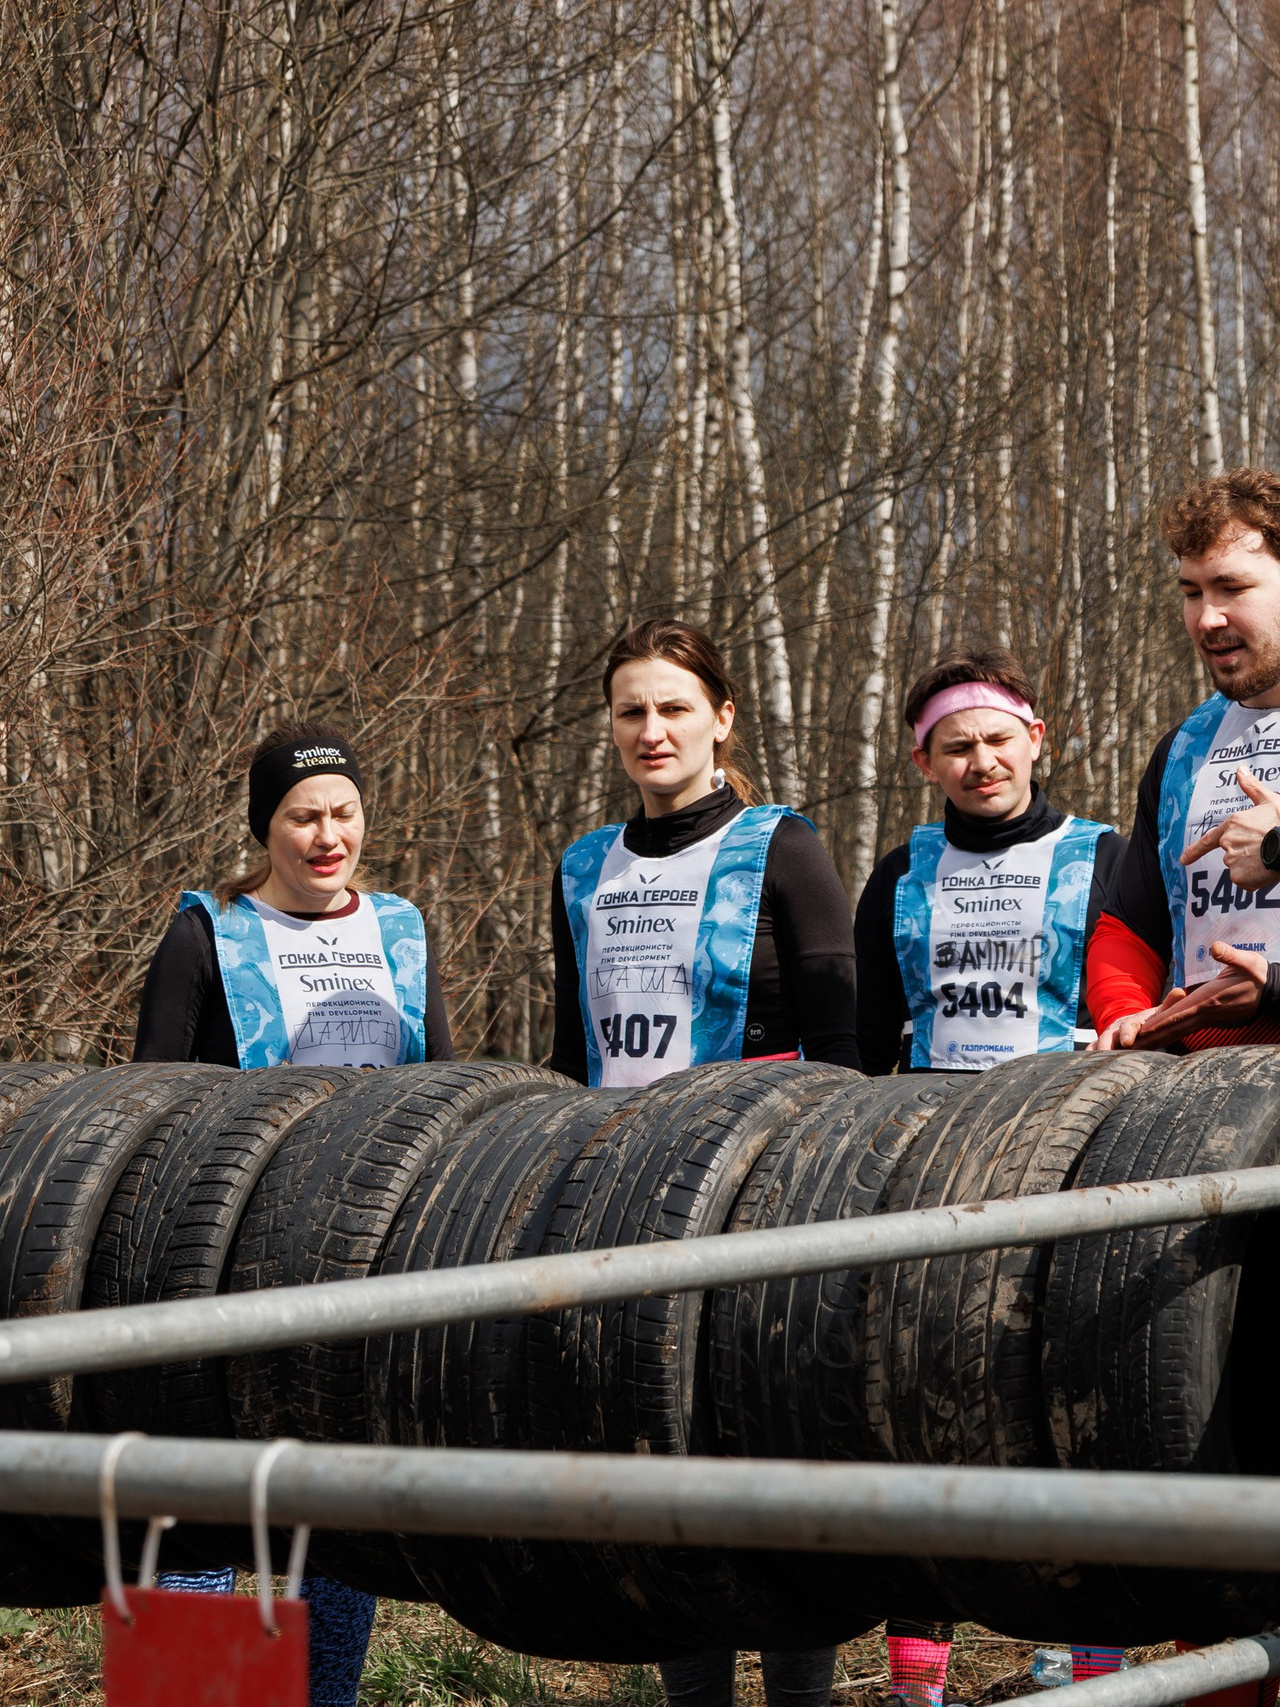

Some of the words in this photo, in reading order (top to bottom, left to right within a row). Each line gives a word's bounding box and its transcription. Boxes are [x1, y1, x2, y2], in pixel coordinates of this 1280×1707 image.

[294, 746, 341, 761] Sminex
[1211, 742, 1252, 760] ГОНКА
[306, 756, 338, 767] team
[1226, 804, 1254, 813] DEVELO
[942, 876, 985, 888] ГОНКА
[990, 875, 1041, 886] ГЕРОЕВ
[597, 890, 639, 905] ГОНКА
[644, 889, 698, 903] ГЕРОЕВ
[953, 896, 1023, 915] Sminex
[605, 916, 676, 936] Sminex
[950, 920, 1022, 929] ПЕРФЕКЦИОНИСТЫ
[969, 929, 1020, 937] DEVELOPMENT
[602, 944, 673, 954] ПЕРФЕКЦИОНИСТЫ
[278, 953, 328, 965] ГОНКА
[332, 951, 382, 965] ГЕРОЕВ
[618, 954, 671, 963] DEVELOPMENT
[299, 974, 376, 992] Sminex
[593, 962, 693, 999] МАША
[306, 1000, 381, 1008] ПЕРФЕКЦИОНИСТЫ
[941, 981, 1028, 1018] 5404
[961, 1044, 1015, 1053] ГАЗПРОМБАНК
